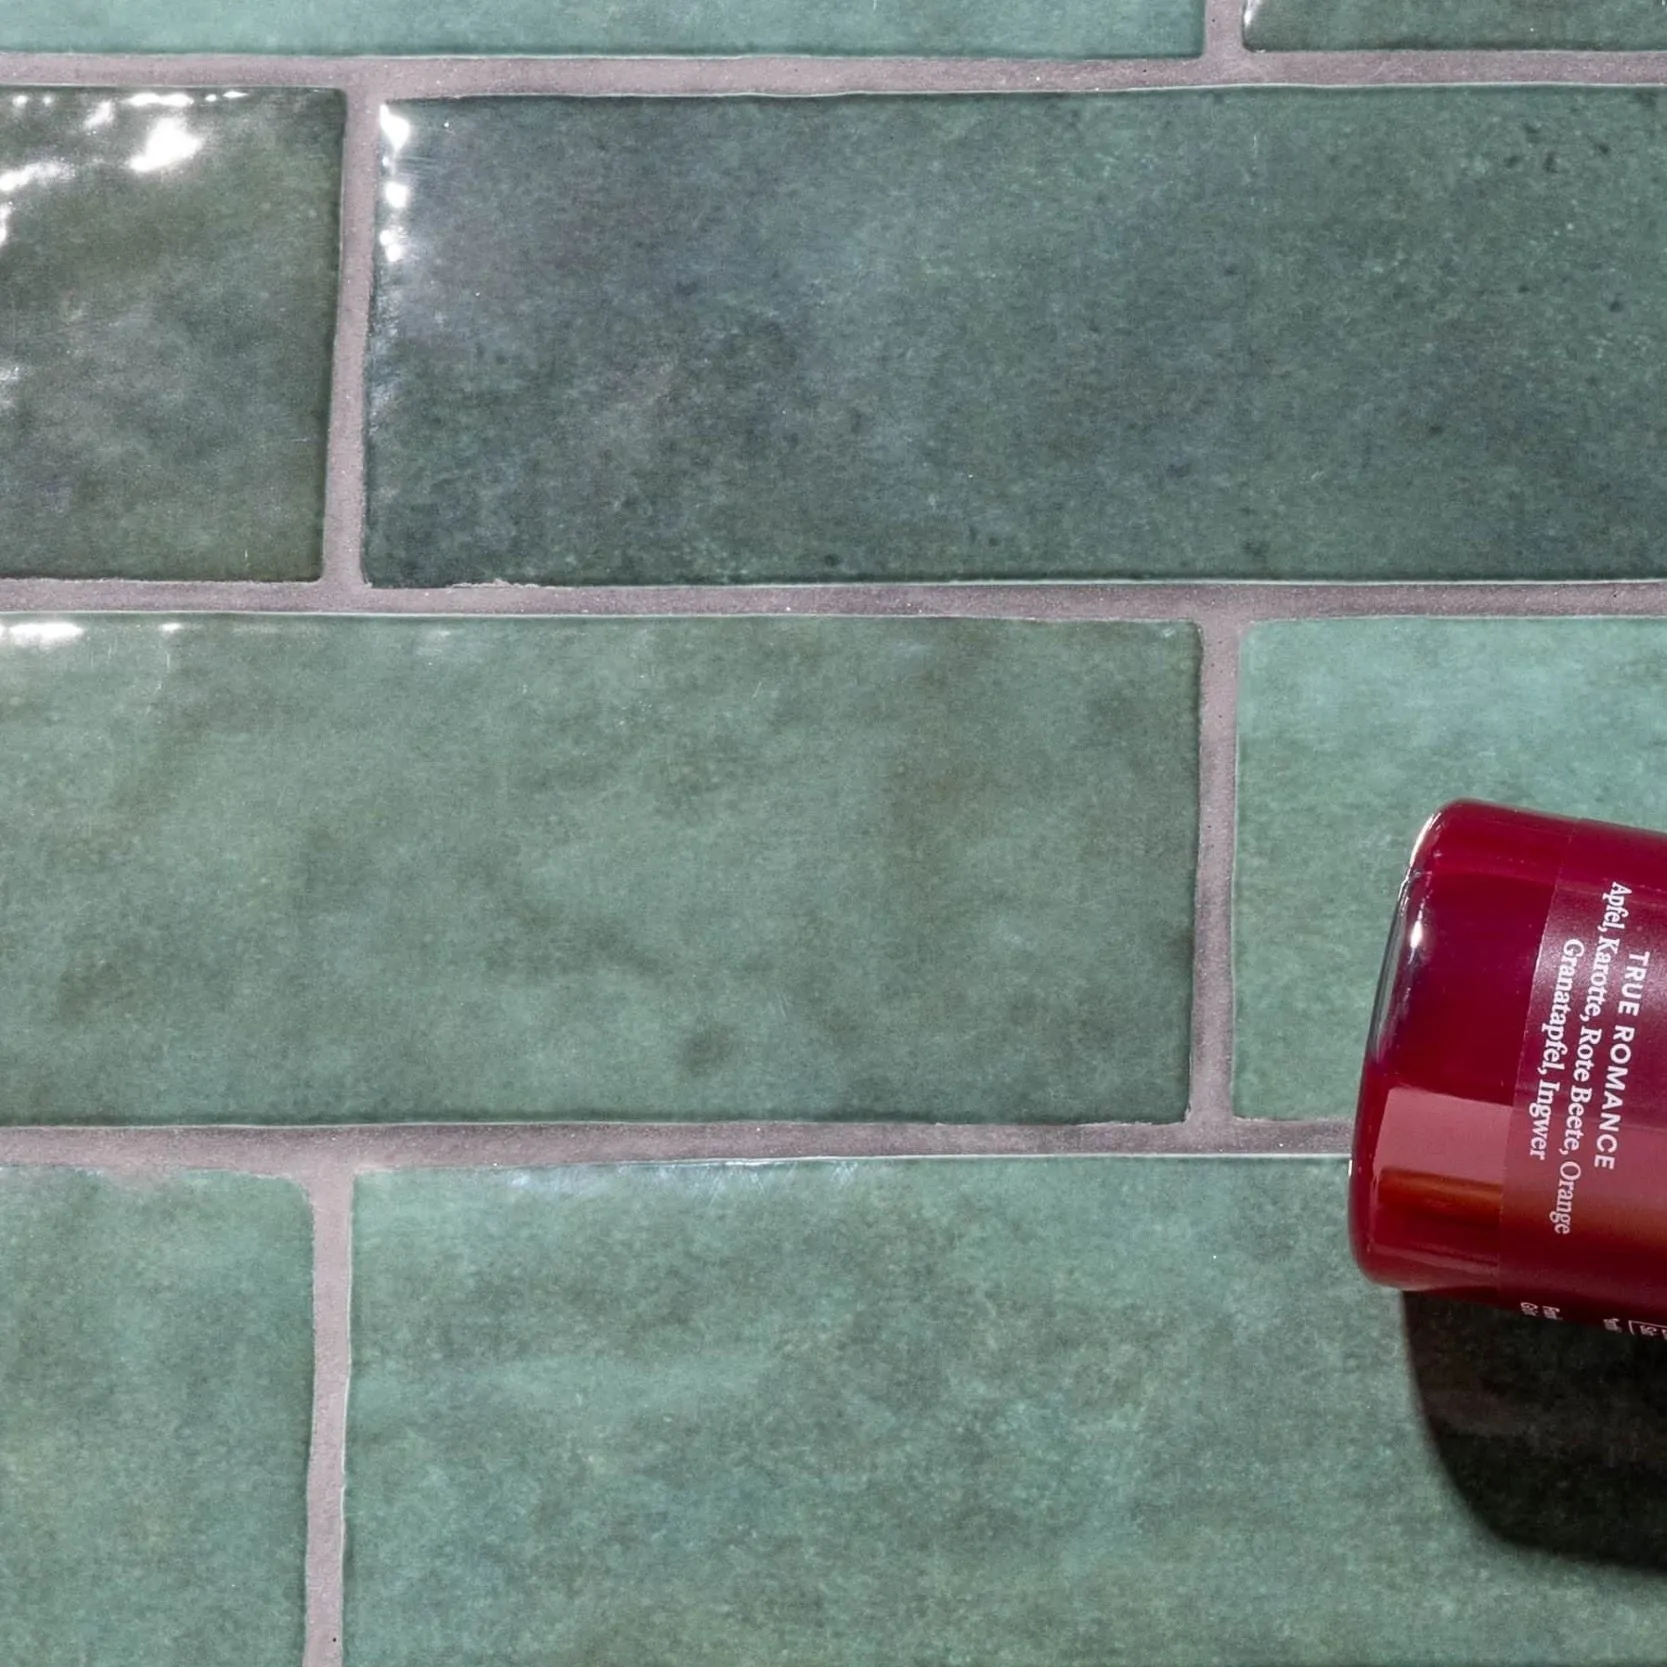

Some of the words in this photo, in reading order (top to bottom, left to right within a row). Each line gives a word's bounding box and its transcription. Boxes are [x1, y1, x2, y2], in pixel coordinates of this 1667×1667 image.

[1597, 881, 1631, 932] Apfel,
[1537, 937, 1587, 1074] Granatapfel,
[1579, 935, 1620, 1021] Karotte,
[1618, 951, 1650, 1015] TRUE
[1573, 1025, 1602, 1081] Rote
[1529, 1079, 1560, 1160] Ingwer
[1558, 1084, 1592, 1155] Beete,
[1594, 1024, 1635, 1169] ROMANCE
[1549, 1160, 1581, 1233] Orange
